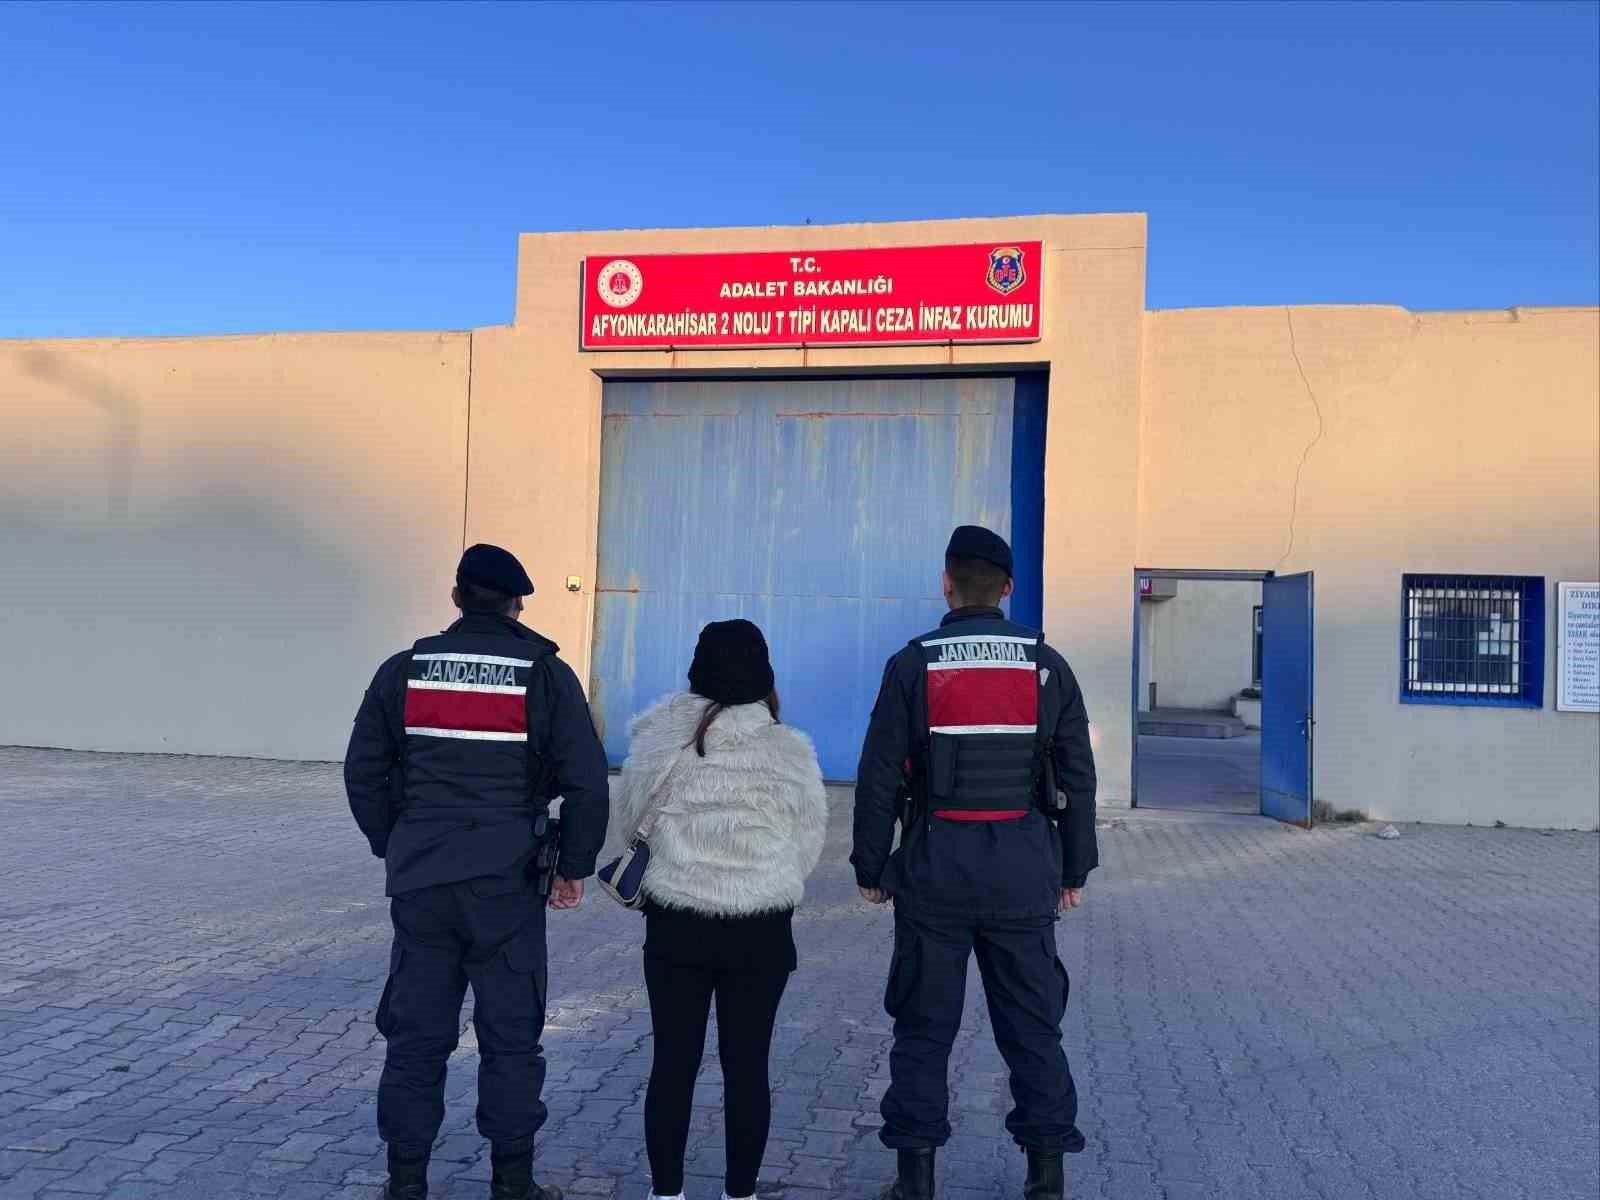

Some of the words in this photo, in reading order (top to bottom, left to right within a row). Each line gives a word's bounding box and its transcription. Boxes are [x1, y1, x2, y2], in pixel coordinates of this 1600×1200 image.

[789, 257, 821, 273] T.C.
[719, 281, 788, 298] ADALET
[793, 275, 893, 296] BAKANLIĞI
[591, 306, 717, 337] AFYONKARAHİSAR
[720, 312, 729, 335] 2
[733, 311, 772, 335] NOLU
[775, 310, 785, 334] T
[788, 304, 817, 334] TİPİ
[820, 308, 872, 333] KAPALI
[875, 307, 914, 332] CEZA
[919, 300, 962, 331] İNFAZ
[966, 303, 1034, 329] KURUMU
[938, 643, 1028, 662] JANDARMA
[421, 660, 517, 686] JANDARMA
